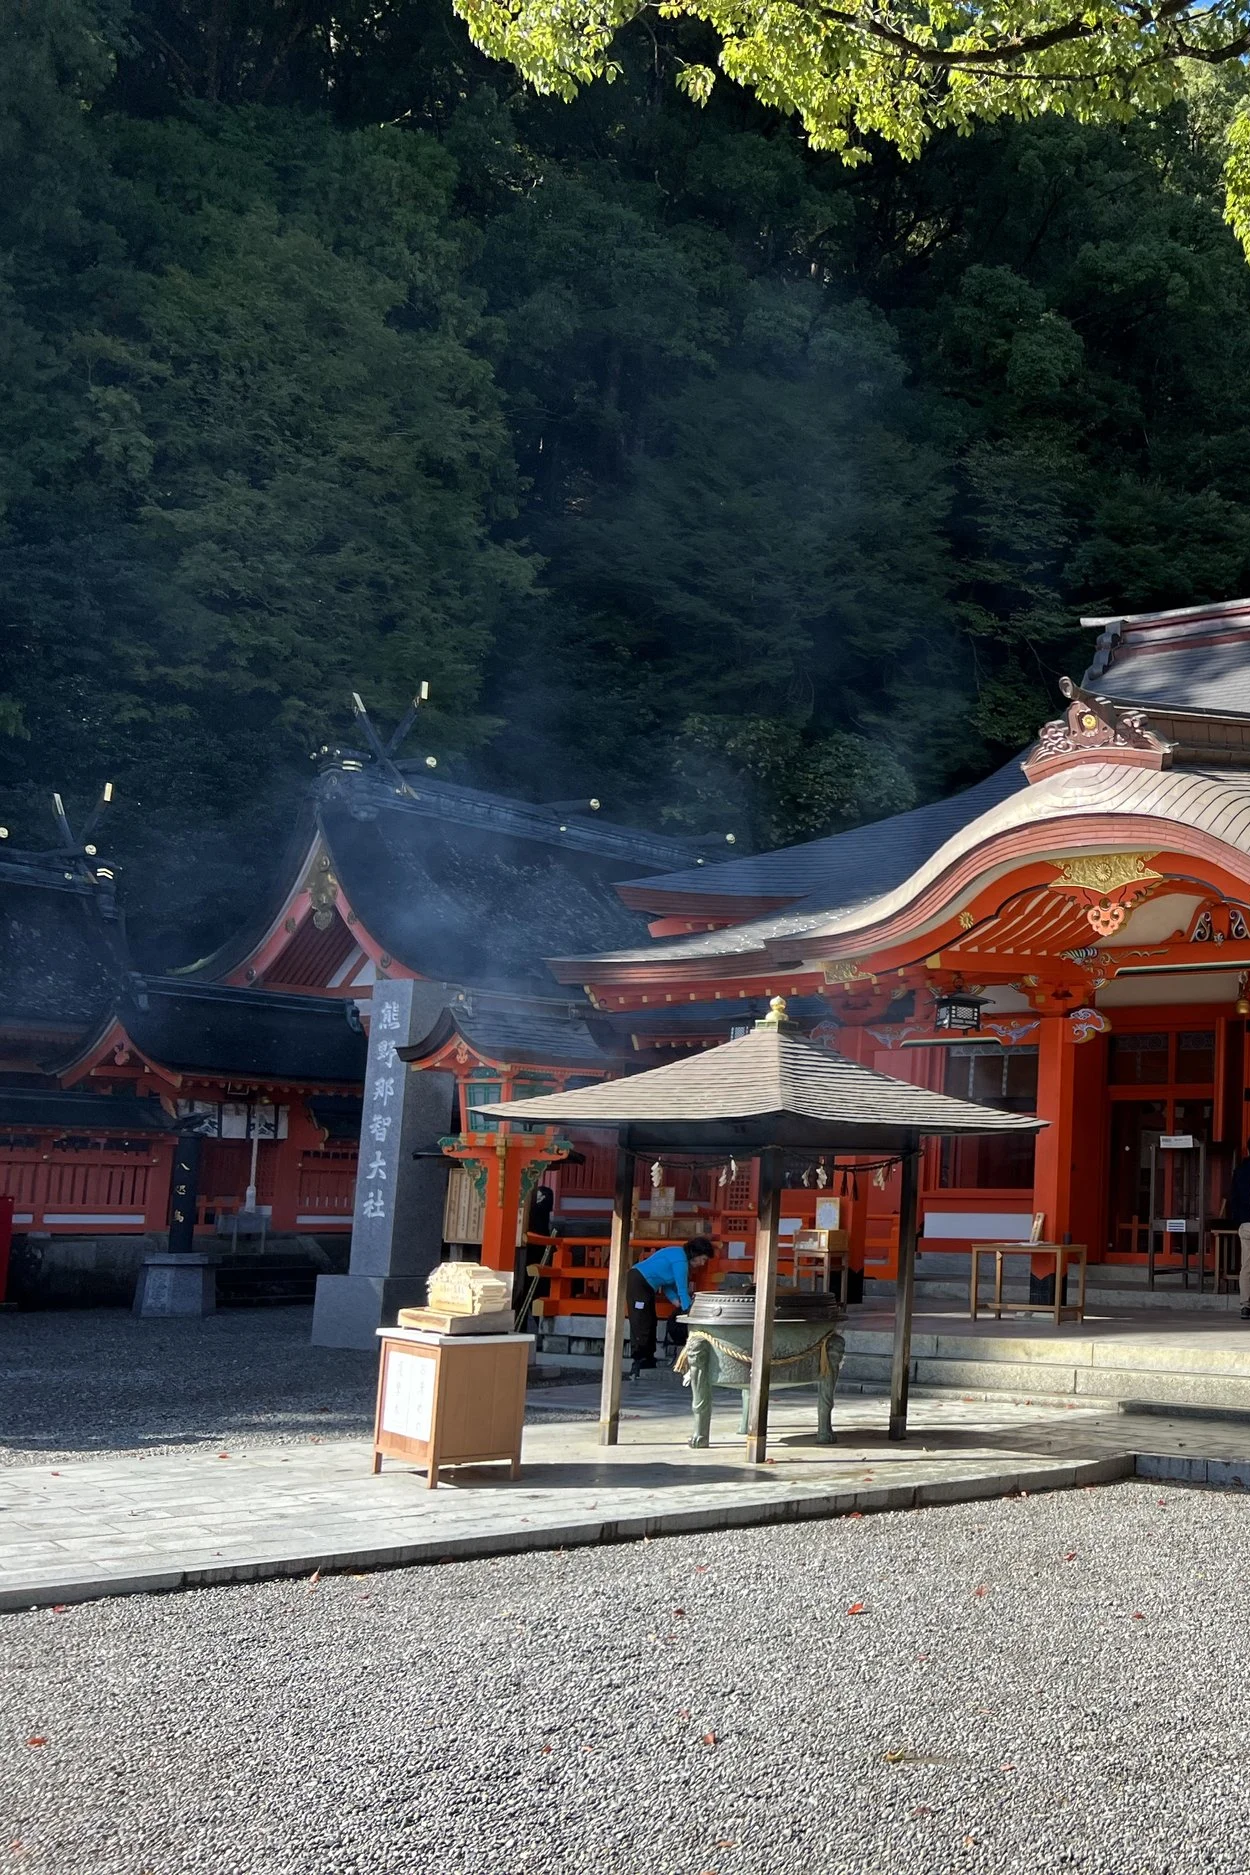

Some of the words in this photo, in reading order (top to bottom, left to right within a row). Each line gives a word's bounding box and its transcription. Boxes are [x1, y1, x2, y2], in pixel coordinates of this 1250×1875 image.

[362, 1001, 401, 1219] 熊野那智大社
